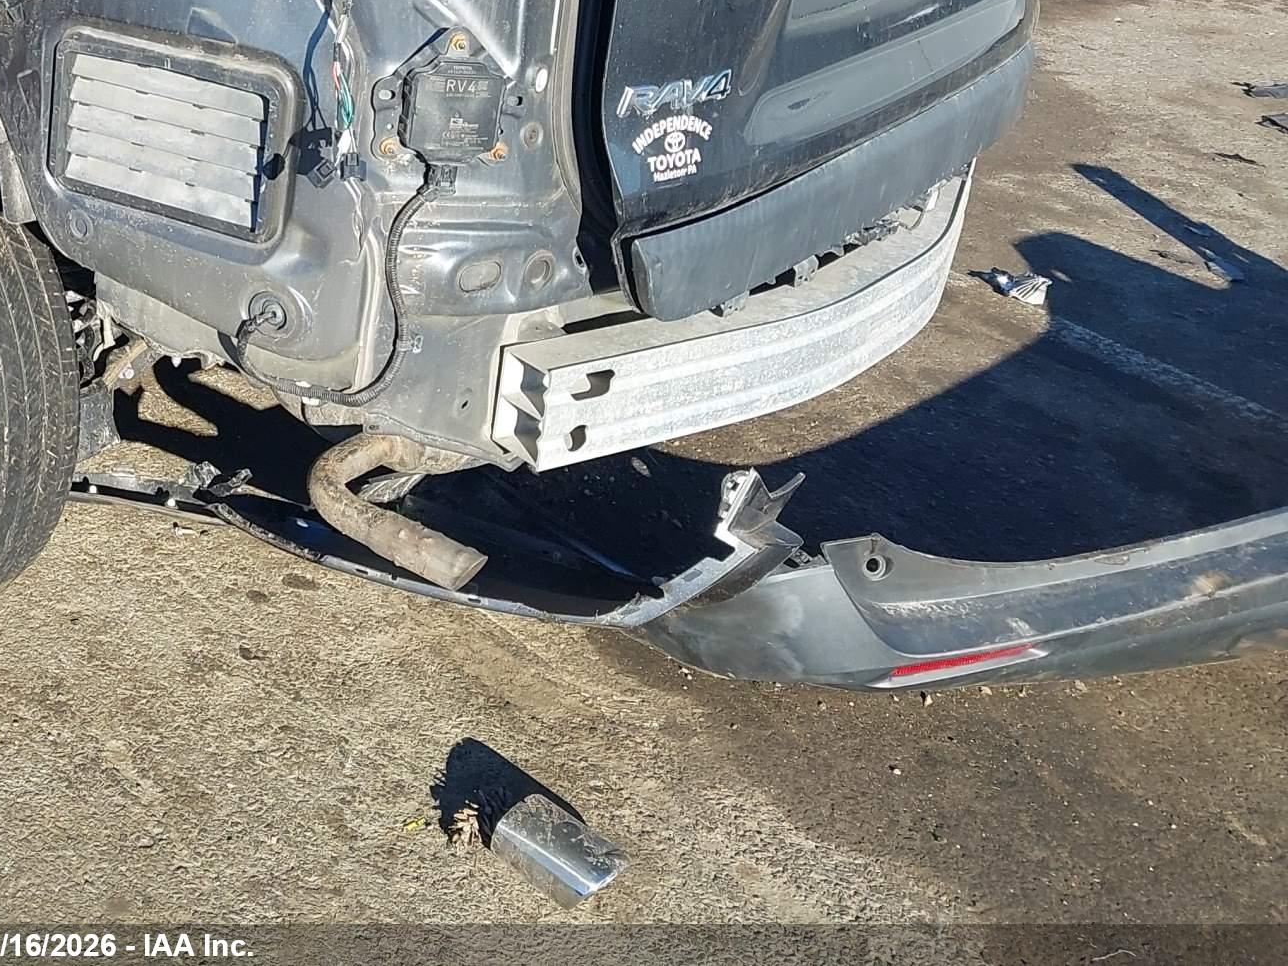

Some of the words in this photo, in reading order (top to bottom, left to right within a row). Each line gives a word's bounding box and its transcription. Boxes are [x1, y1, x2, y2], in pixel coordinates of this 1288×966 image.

[446, 79, 477, 93] RV4
[616, 68, 732, 118] RAV4
[632, 114, 713, 155] INDEPENDENCE
[647, 147, 702, 172] TOYOTA
[687, 164, 698, 175] PA
